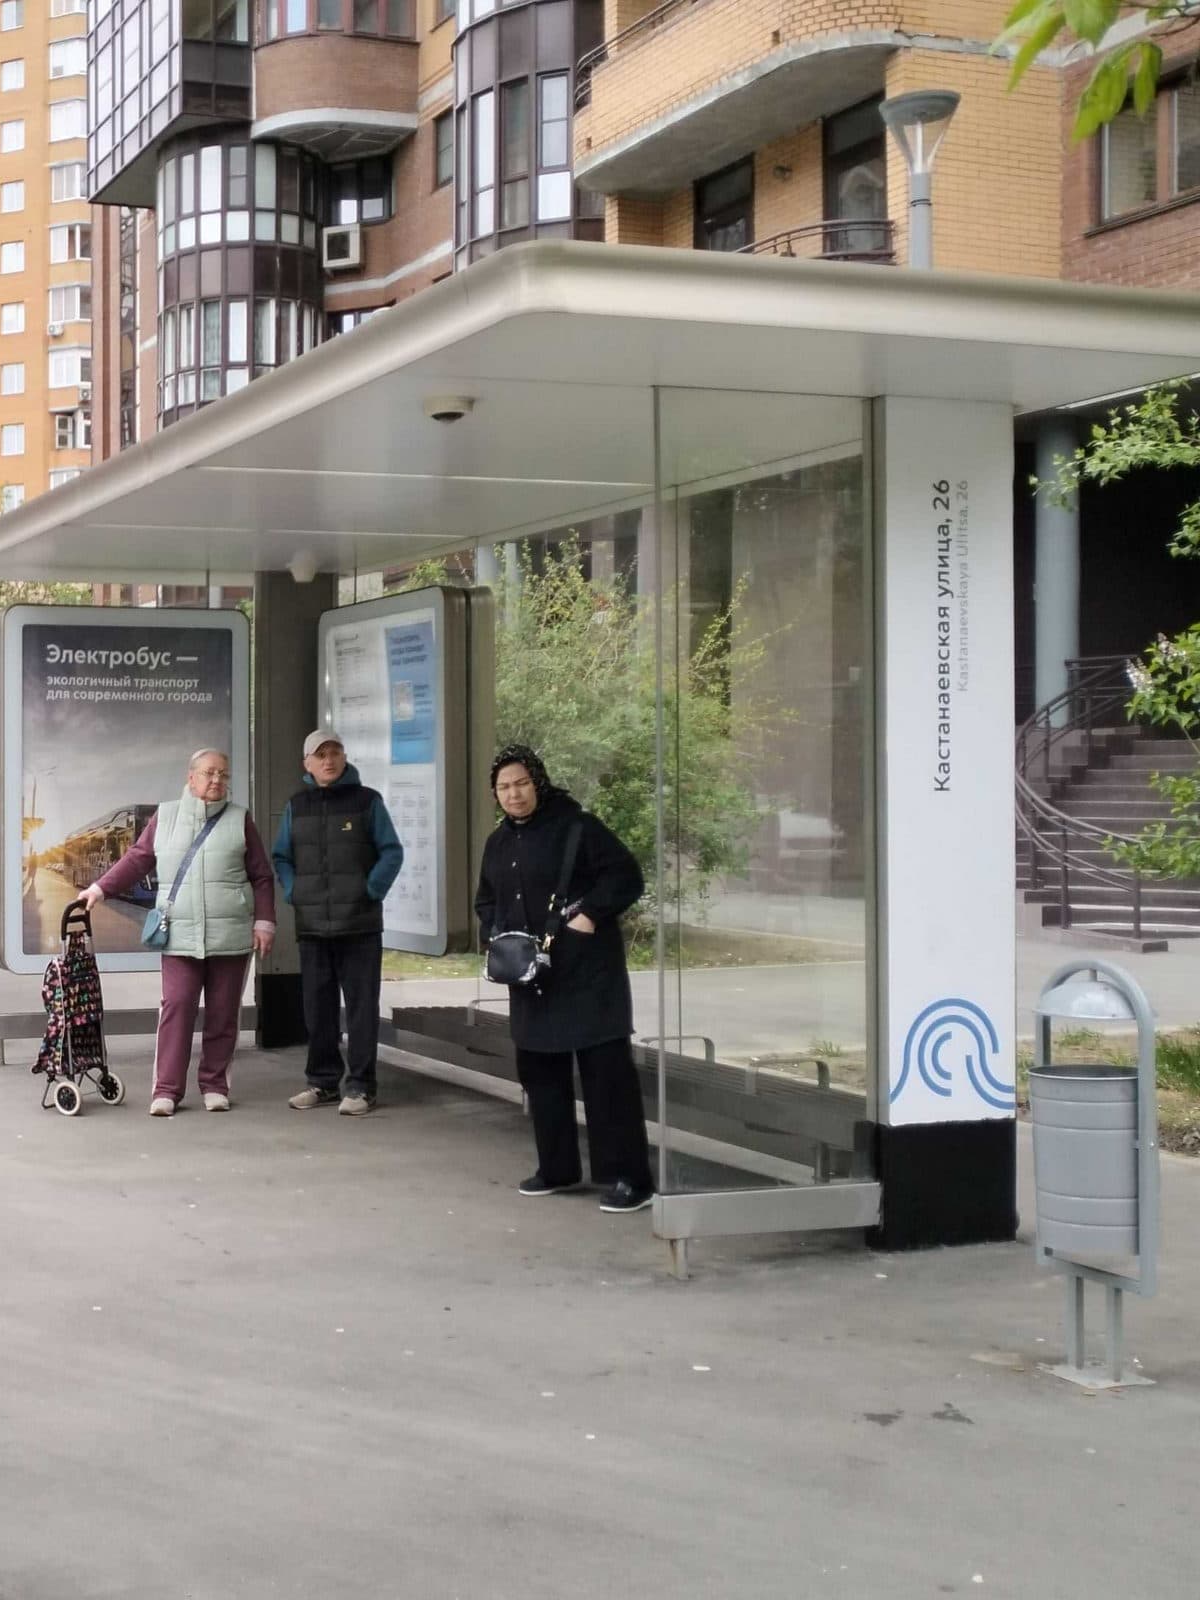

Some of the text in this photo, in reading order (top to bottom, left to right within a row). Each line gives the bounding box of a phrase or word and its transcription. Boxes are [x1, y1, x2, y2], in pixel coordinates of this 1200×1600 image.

[956, 479, 969, 501] 26
[932, 479, 954, 792] Кастанаевская улица, 26
[45, 643, 172, 670] Электробус
[46, 675, 200, 690] экологичный транспорт
[45, 690, 213, 704] для современного города
